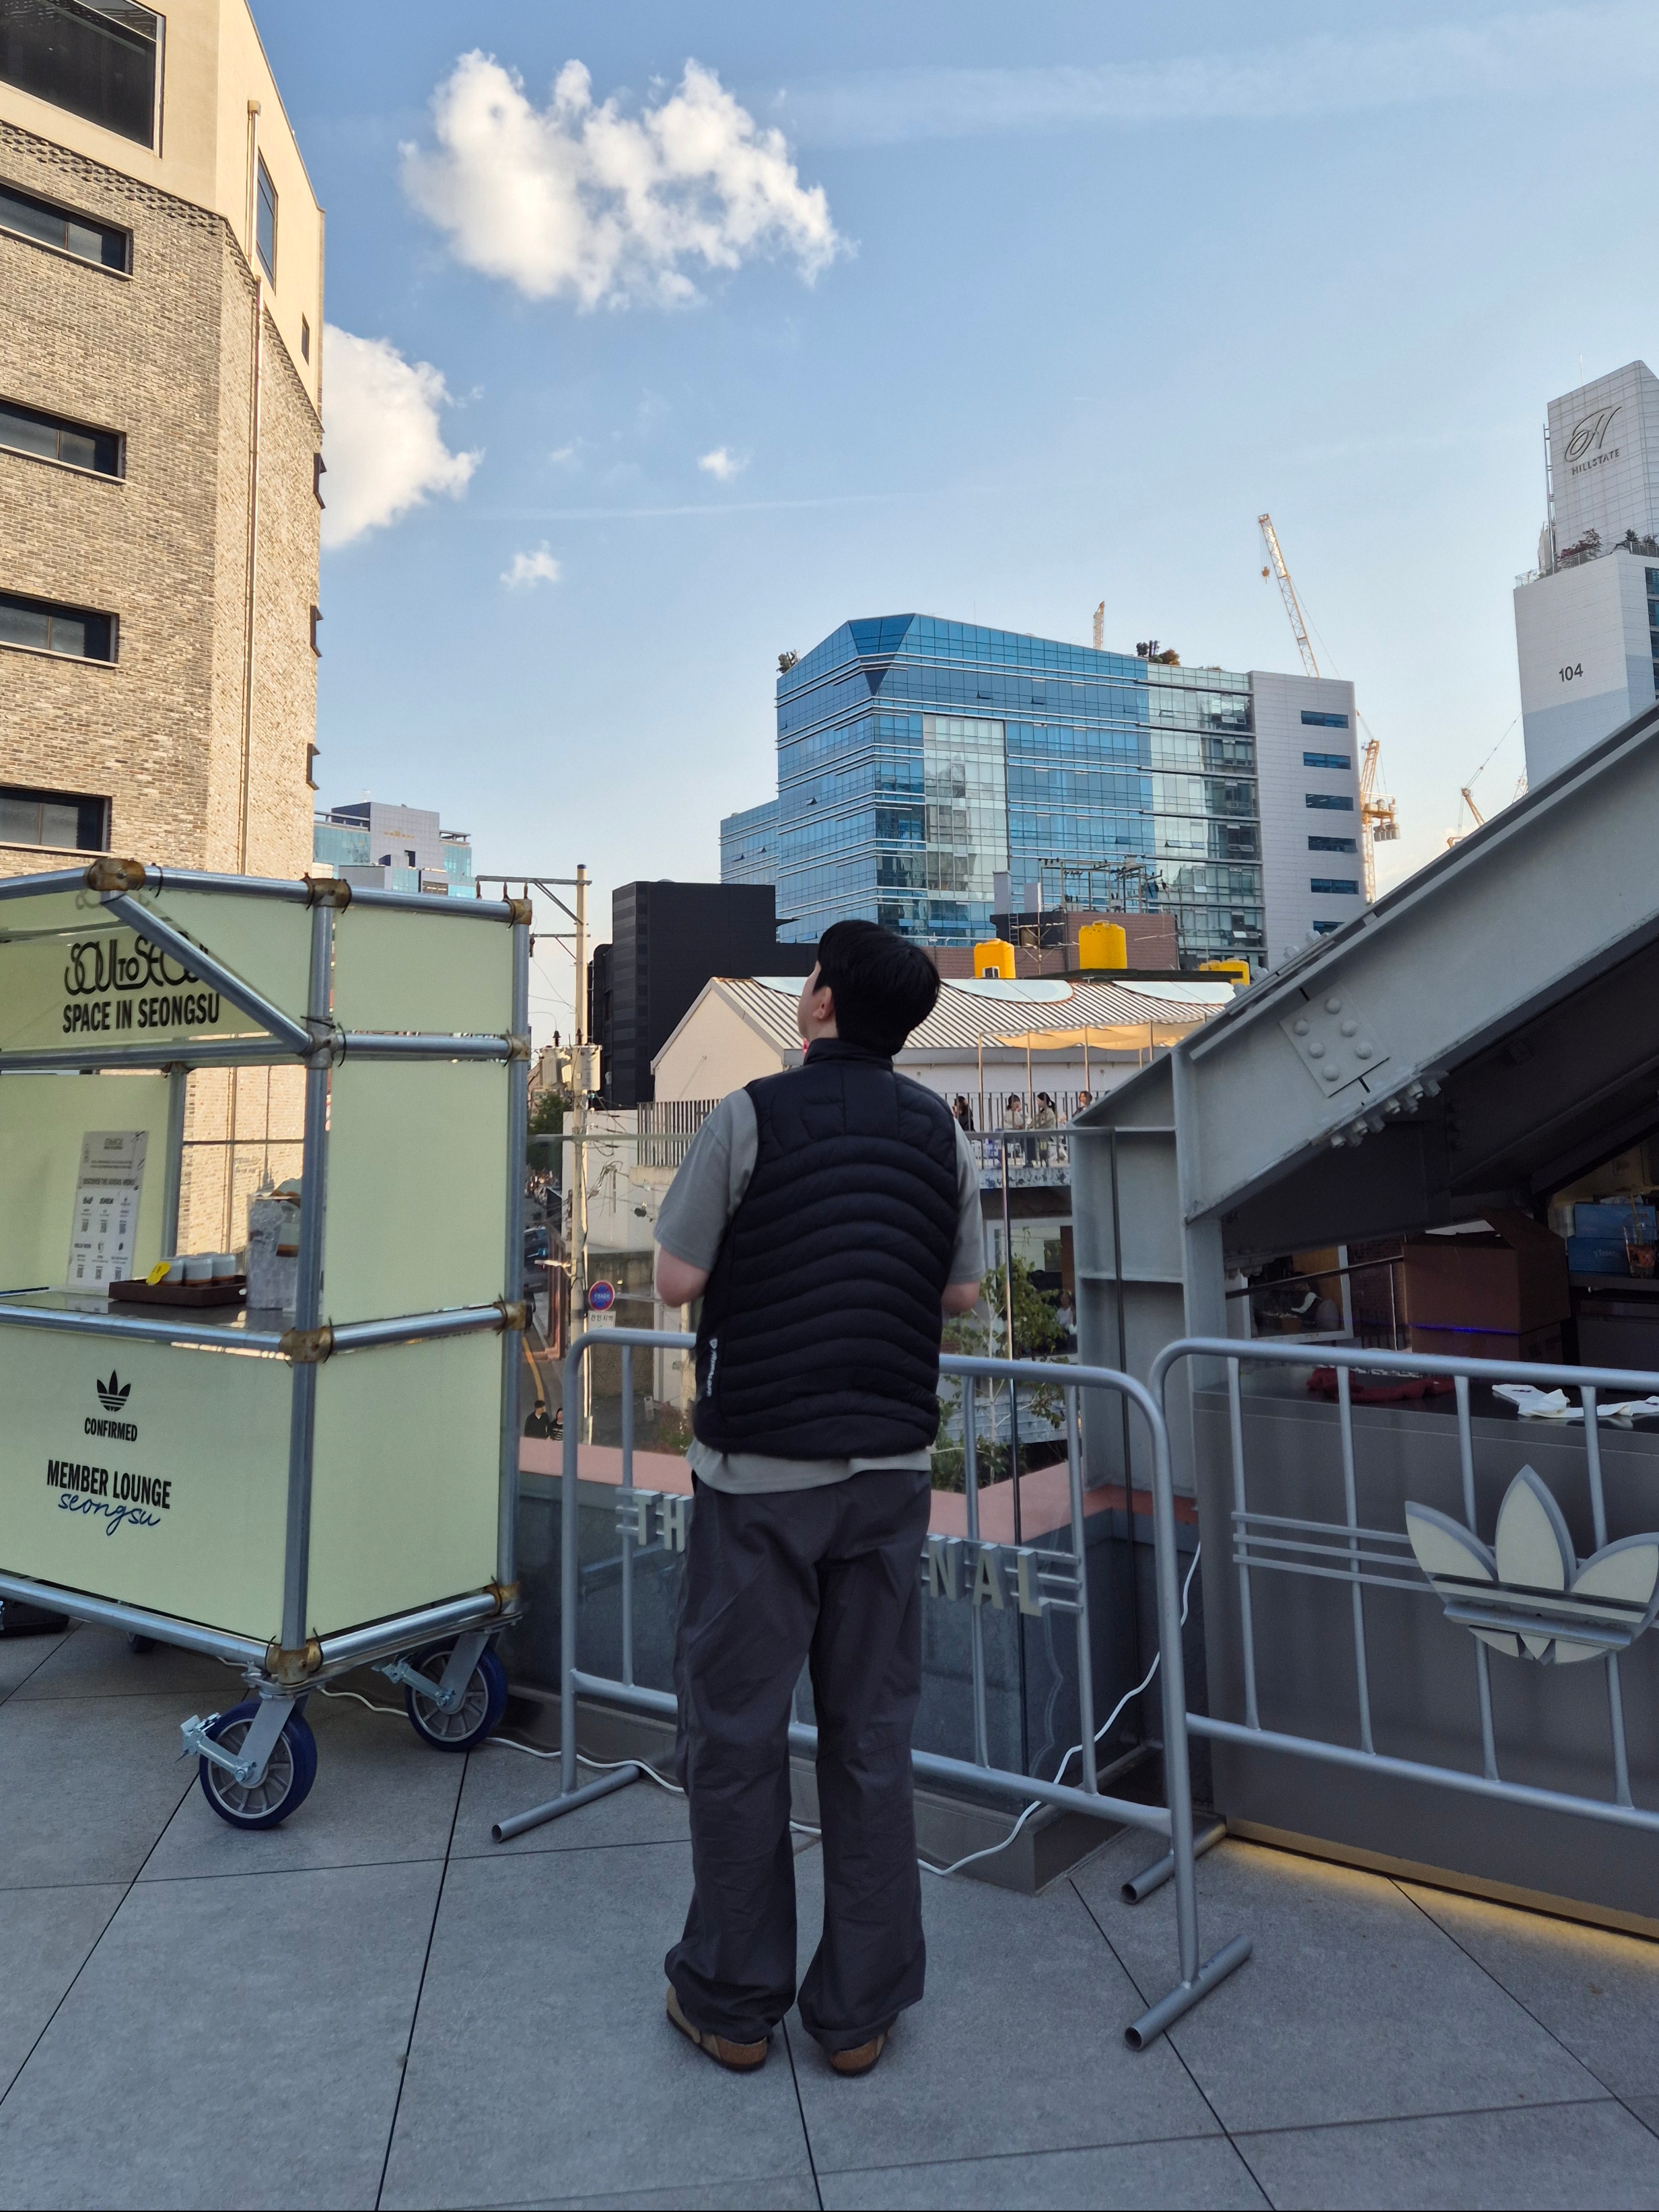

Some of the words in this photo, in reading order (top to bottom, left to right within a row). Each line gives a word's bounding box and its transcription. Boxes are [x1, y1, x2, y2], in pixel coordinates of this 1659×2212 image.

[1572, 448, 1620, 476] HILLSTATE
[1559, 662, 1584, 682] 104
[62, 1001, 111, 1033] SPACE
[115, 999, 132, 1030] IN
[137, 993, 220, 1028] SEONGSU
[84, 1417, 138, 1441] CONFIRMED
[46, 1459, 109, 1497] MEMBER
[112, 1470, 172, 1509] LOUNGE
[58, 1493, 161, 1536] seongsu
